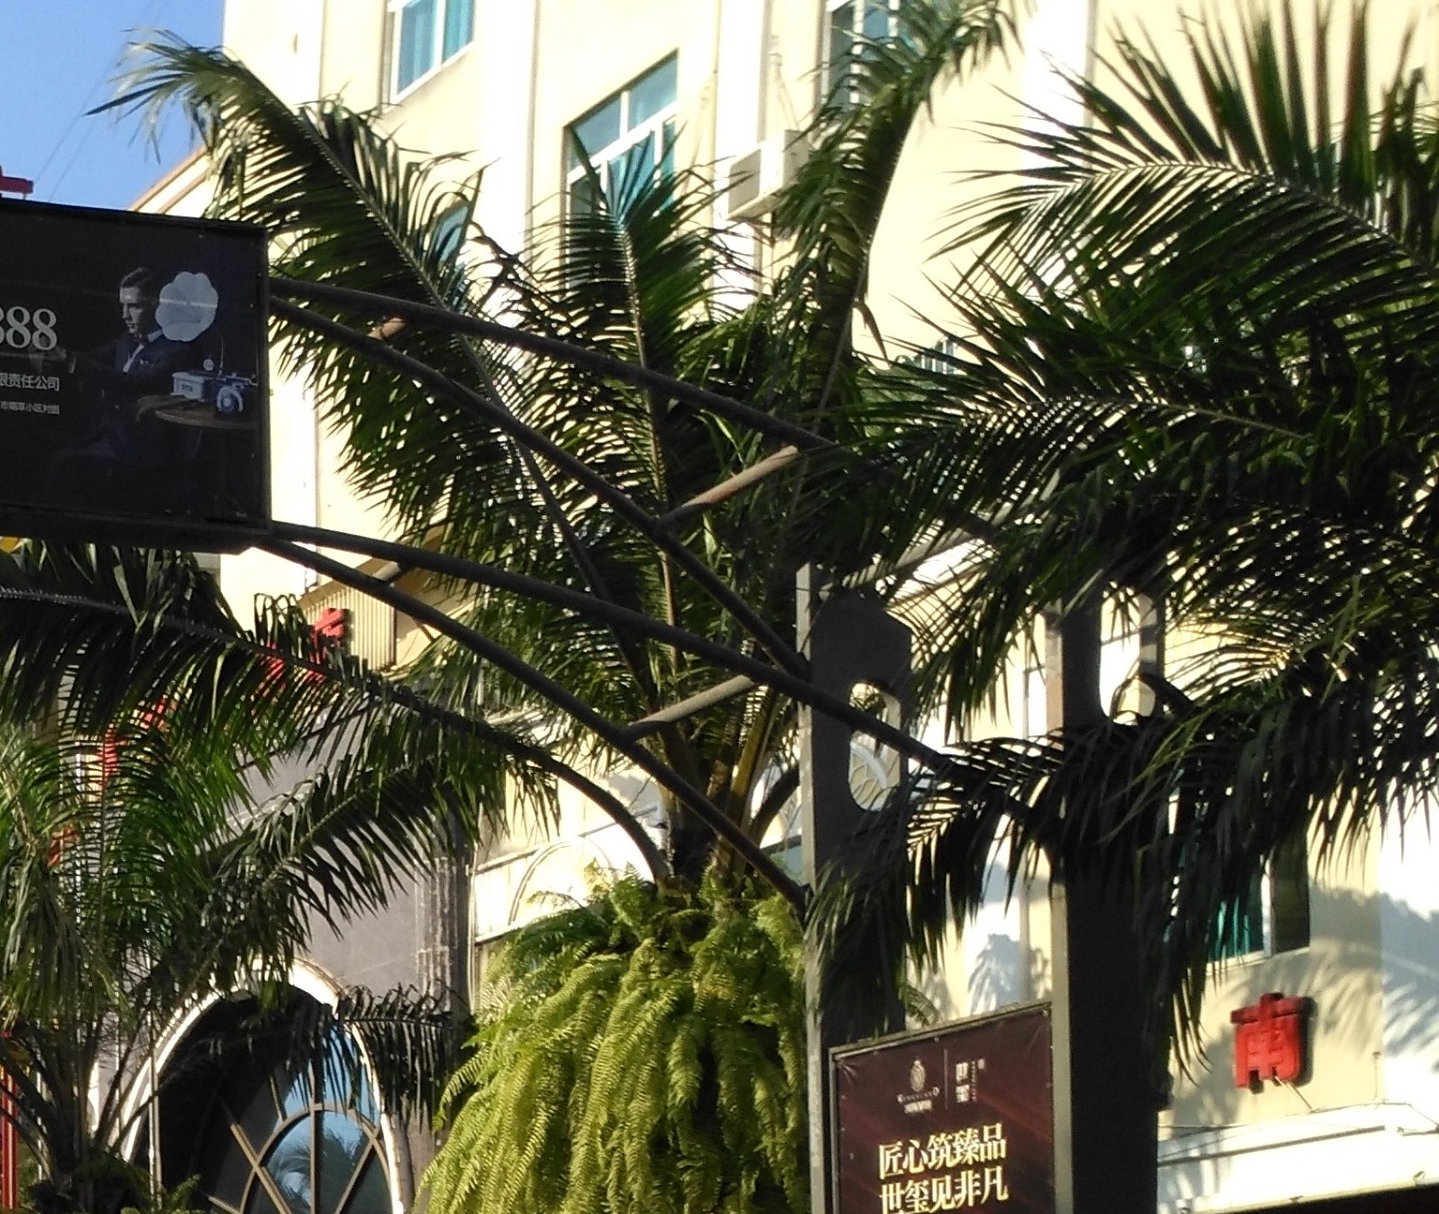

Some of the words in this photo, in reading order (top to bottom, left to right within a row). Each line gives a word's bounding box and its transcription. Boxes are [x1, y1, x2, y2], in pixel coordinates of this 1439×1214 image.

[878, 1122, 1007, 1181] 匠心筑臻品
